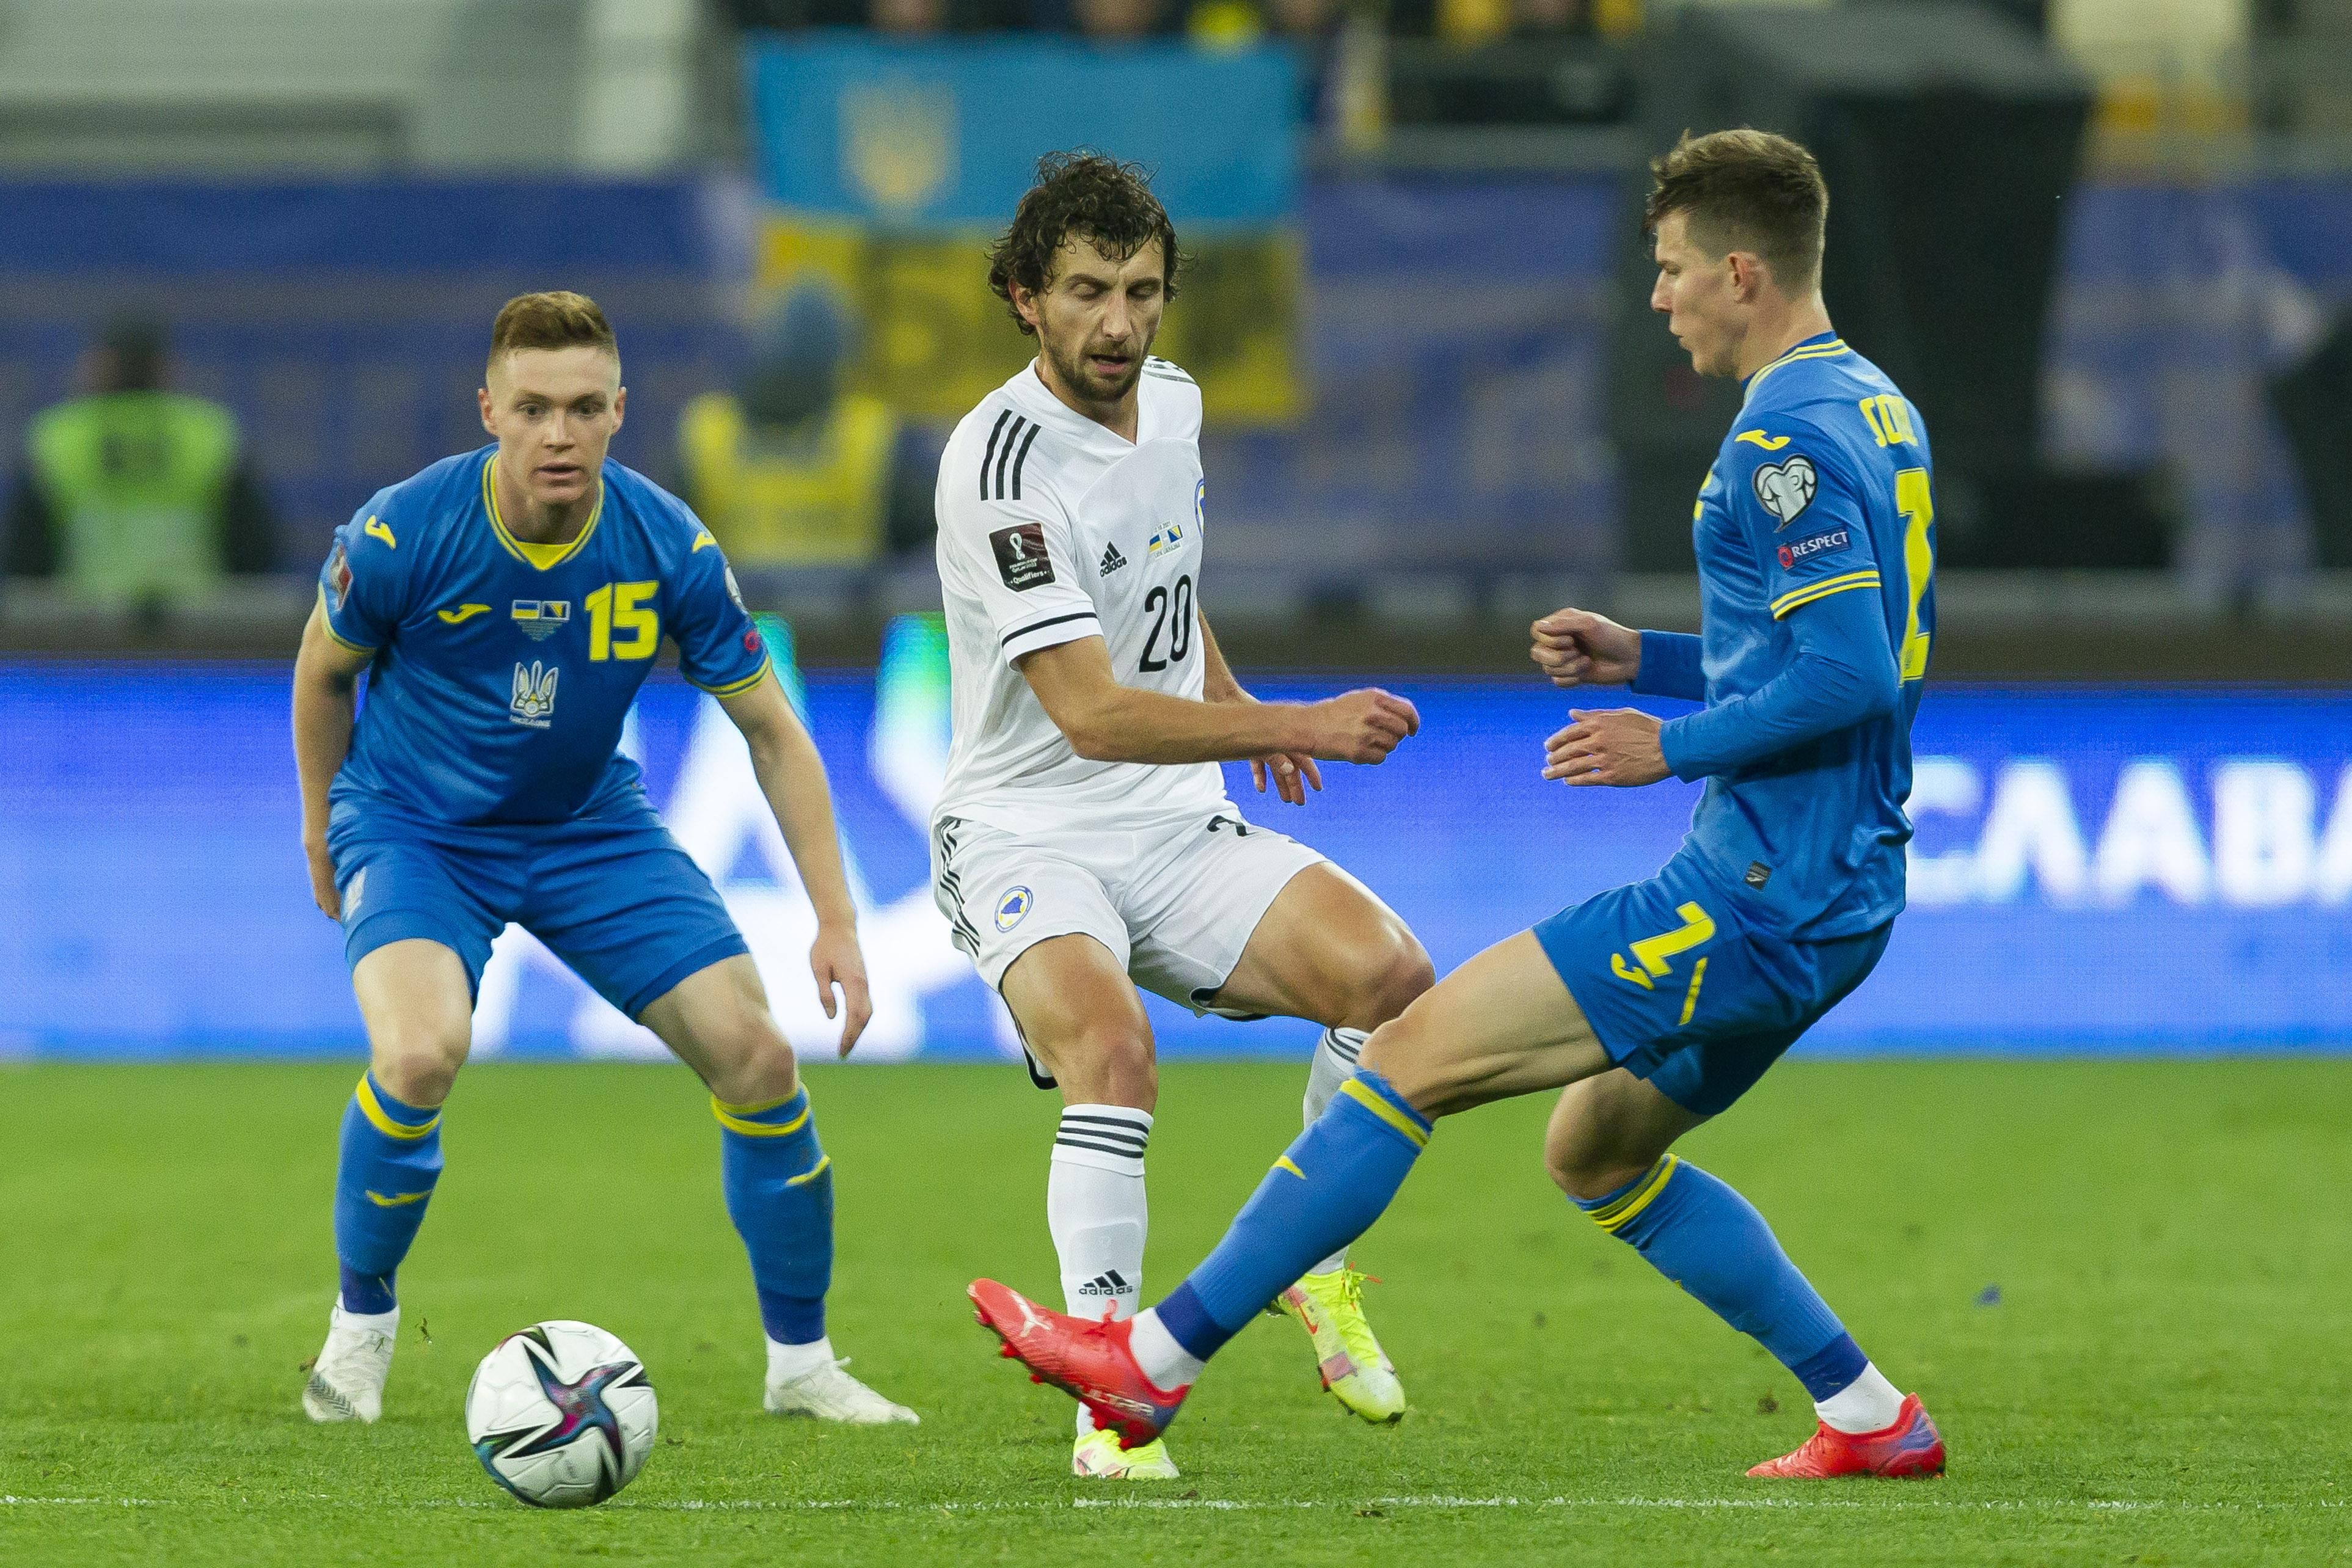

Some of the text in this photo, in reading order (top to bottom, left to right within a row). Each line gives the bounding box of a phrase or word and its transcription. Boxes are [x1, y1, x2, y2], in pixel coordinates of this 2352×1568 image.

[1791, 531, 1848, 558] RESPECT
[1013, 571, 1045, 585] Qualifiers
[1100, 556, 1128, 577] adidas
[585, 580, 659, 662] 15
[1139, 574, 1191, 673] 20
[1079, 1286, 1133, 1296] adidas
